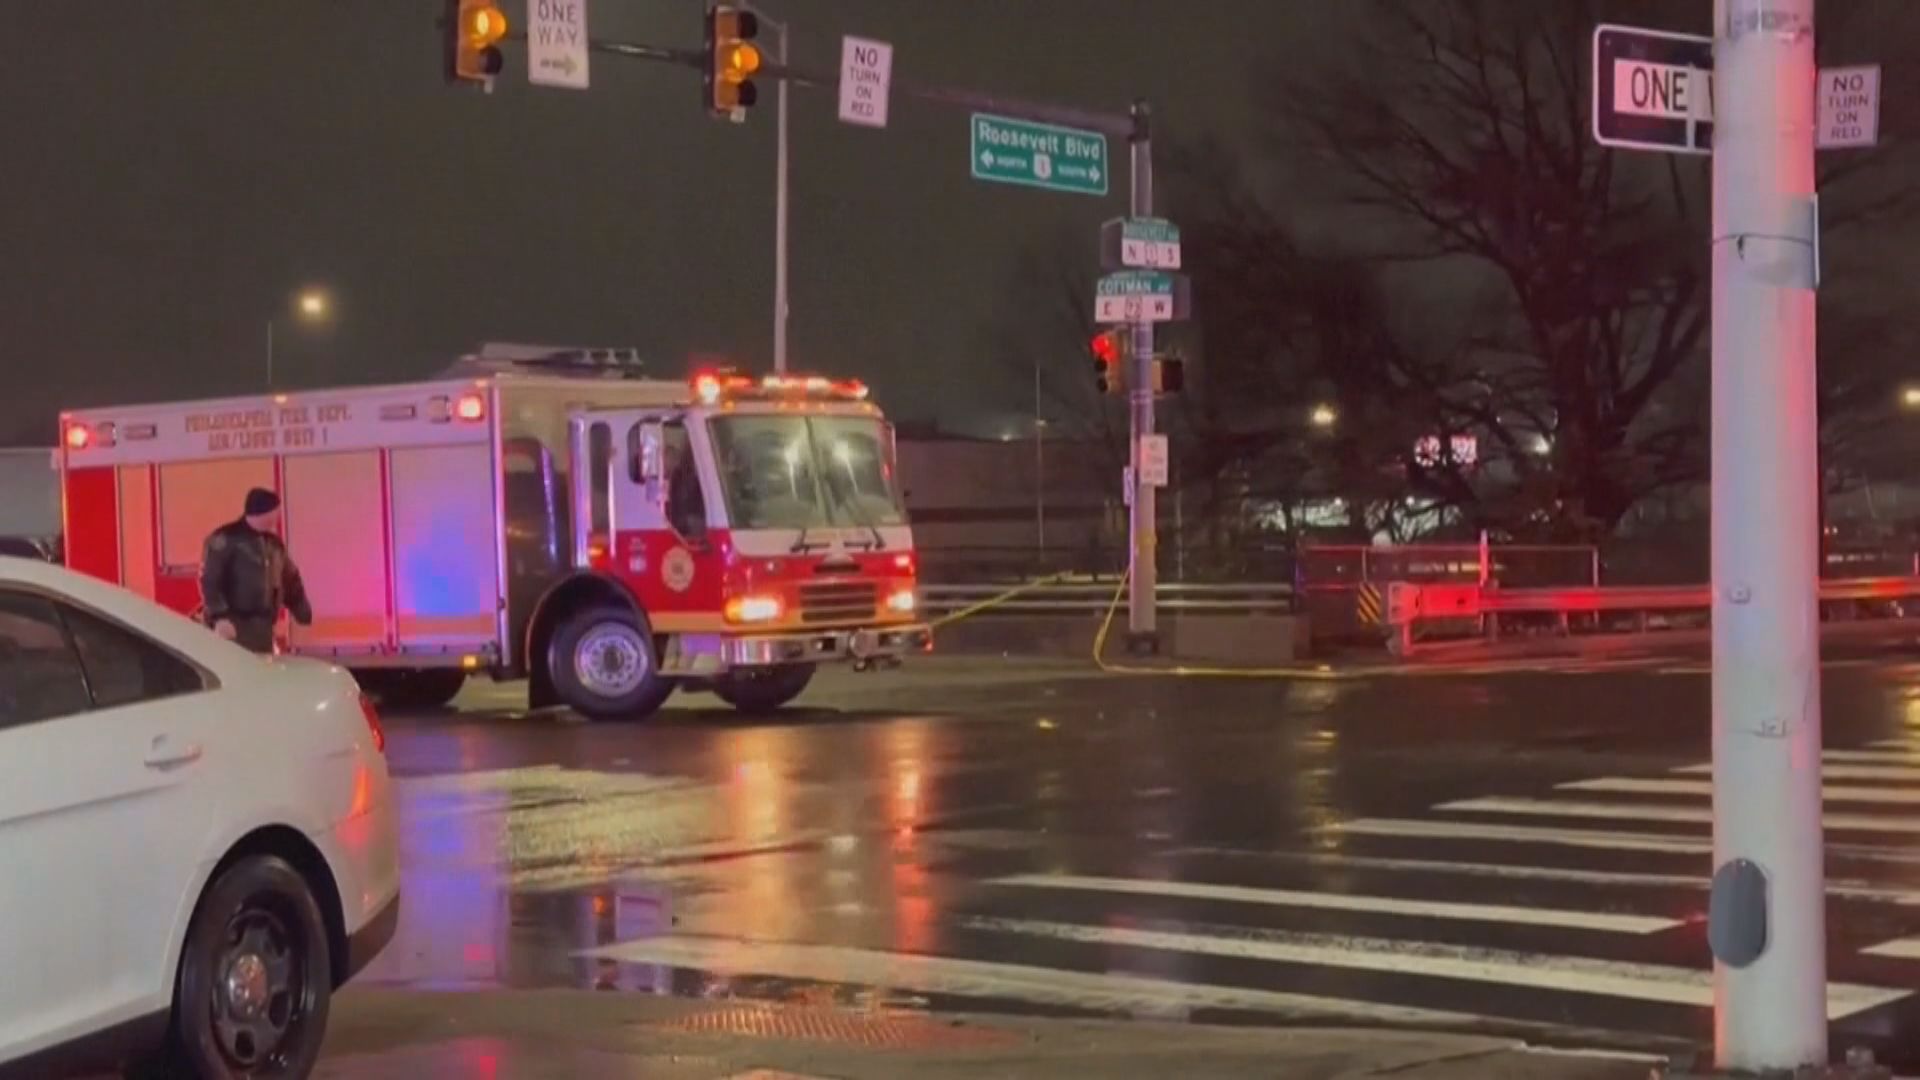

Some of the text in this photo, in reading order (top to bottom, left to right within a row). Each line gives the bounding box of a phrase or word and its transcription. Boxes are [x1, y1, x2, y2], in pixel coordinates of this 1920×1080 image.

[538, 0, 577, 25] ONE
[538, 25, 577, 47] WAY
[855, 46, 878, 68] NO
[850, 66, 880, 86] TURN
[1833, 74, 1864, 92] NO
[856, 86, 872, 100] ON
[1631, 66, 1688, 112] ONE
[851, 101, 874, 117] RED
[1829, 94, 1868, 108] TURN
[1836, 111, 1857, 124] ON
[979, 121, 1100, 160] Roosevelt Blvd
[1831, 126, 1862, 139] RED
[1128, 244, 1137, 259] N
[1167, 247, 1175, 263] S
[1098, 279, 1152, 295] COTTMAN
[1104, 301, 1112, 316] E
[1154, 300, 1165, 313] W
